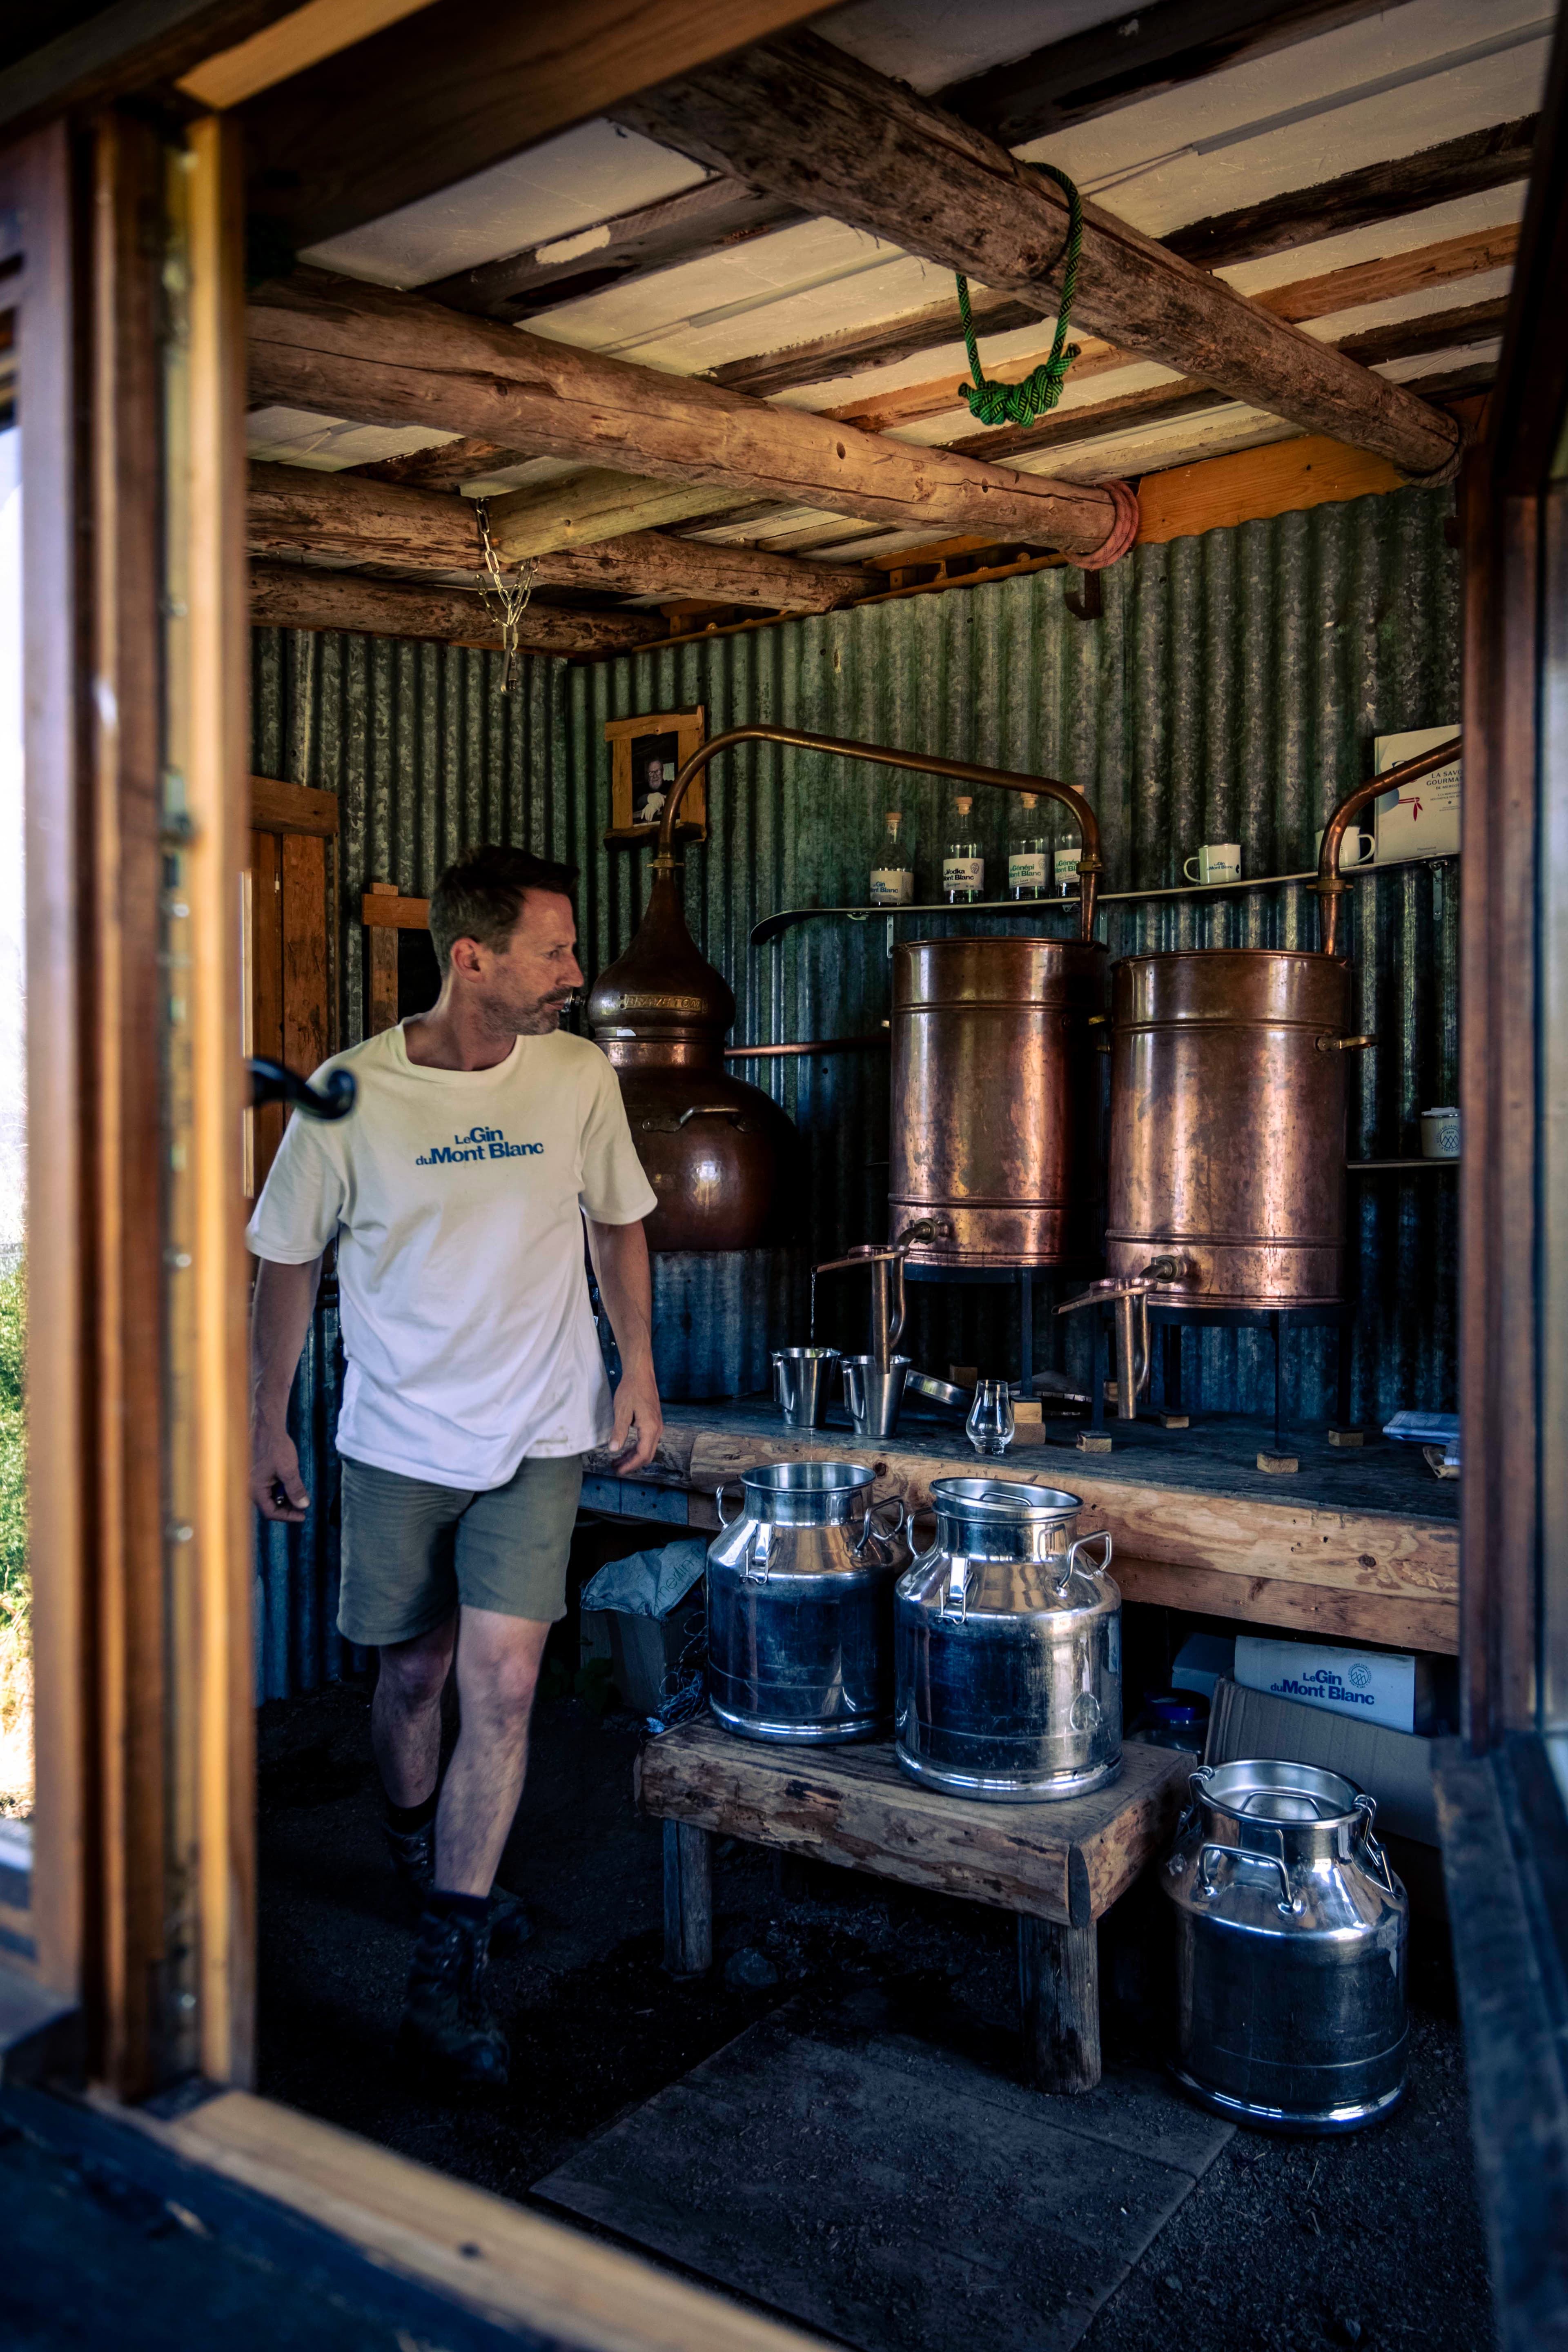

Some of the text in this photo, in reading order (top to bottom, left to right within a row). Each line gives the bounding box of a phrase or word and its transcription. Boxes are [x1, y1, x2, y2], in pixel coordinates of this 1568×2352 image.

[625, 996, 701, 1009] BRAVE TOM
[488, 1142, 544, 1159] Blanc
[1328, 1686, 1375, 1705] Blanc
